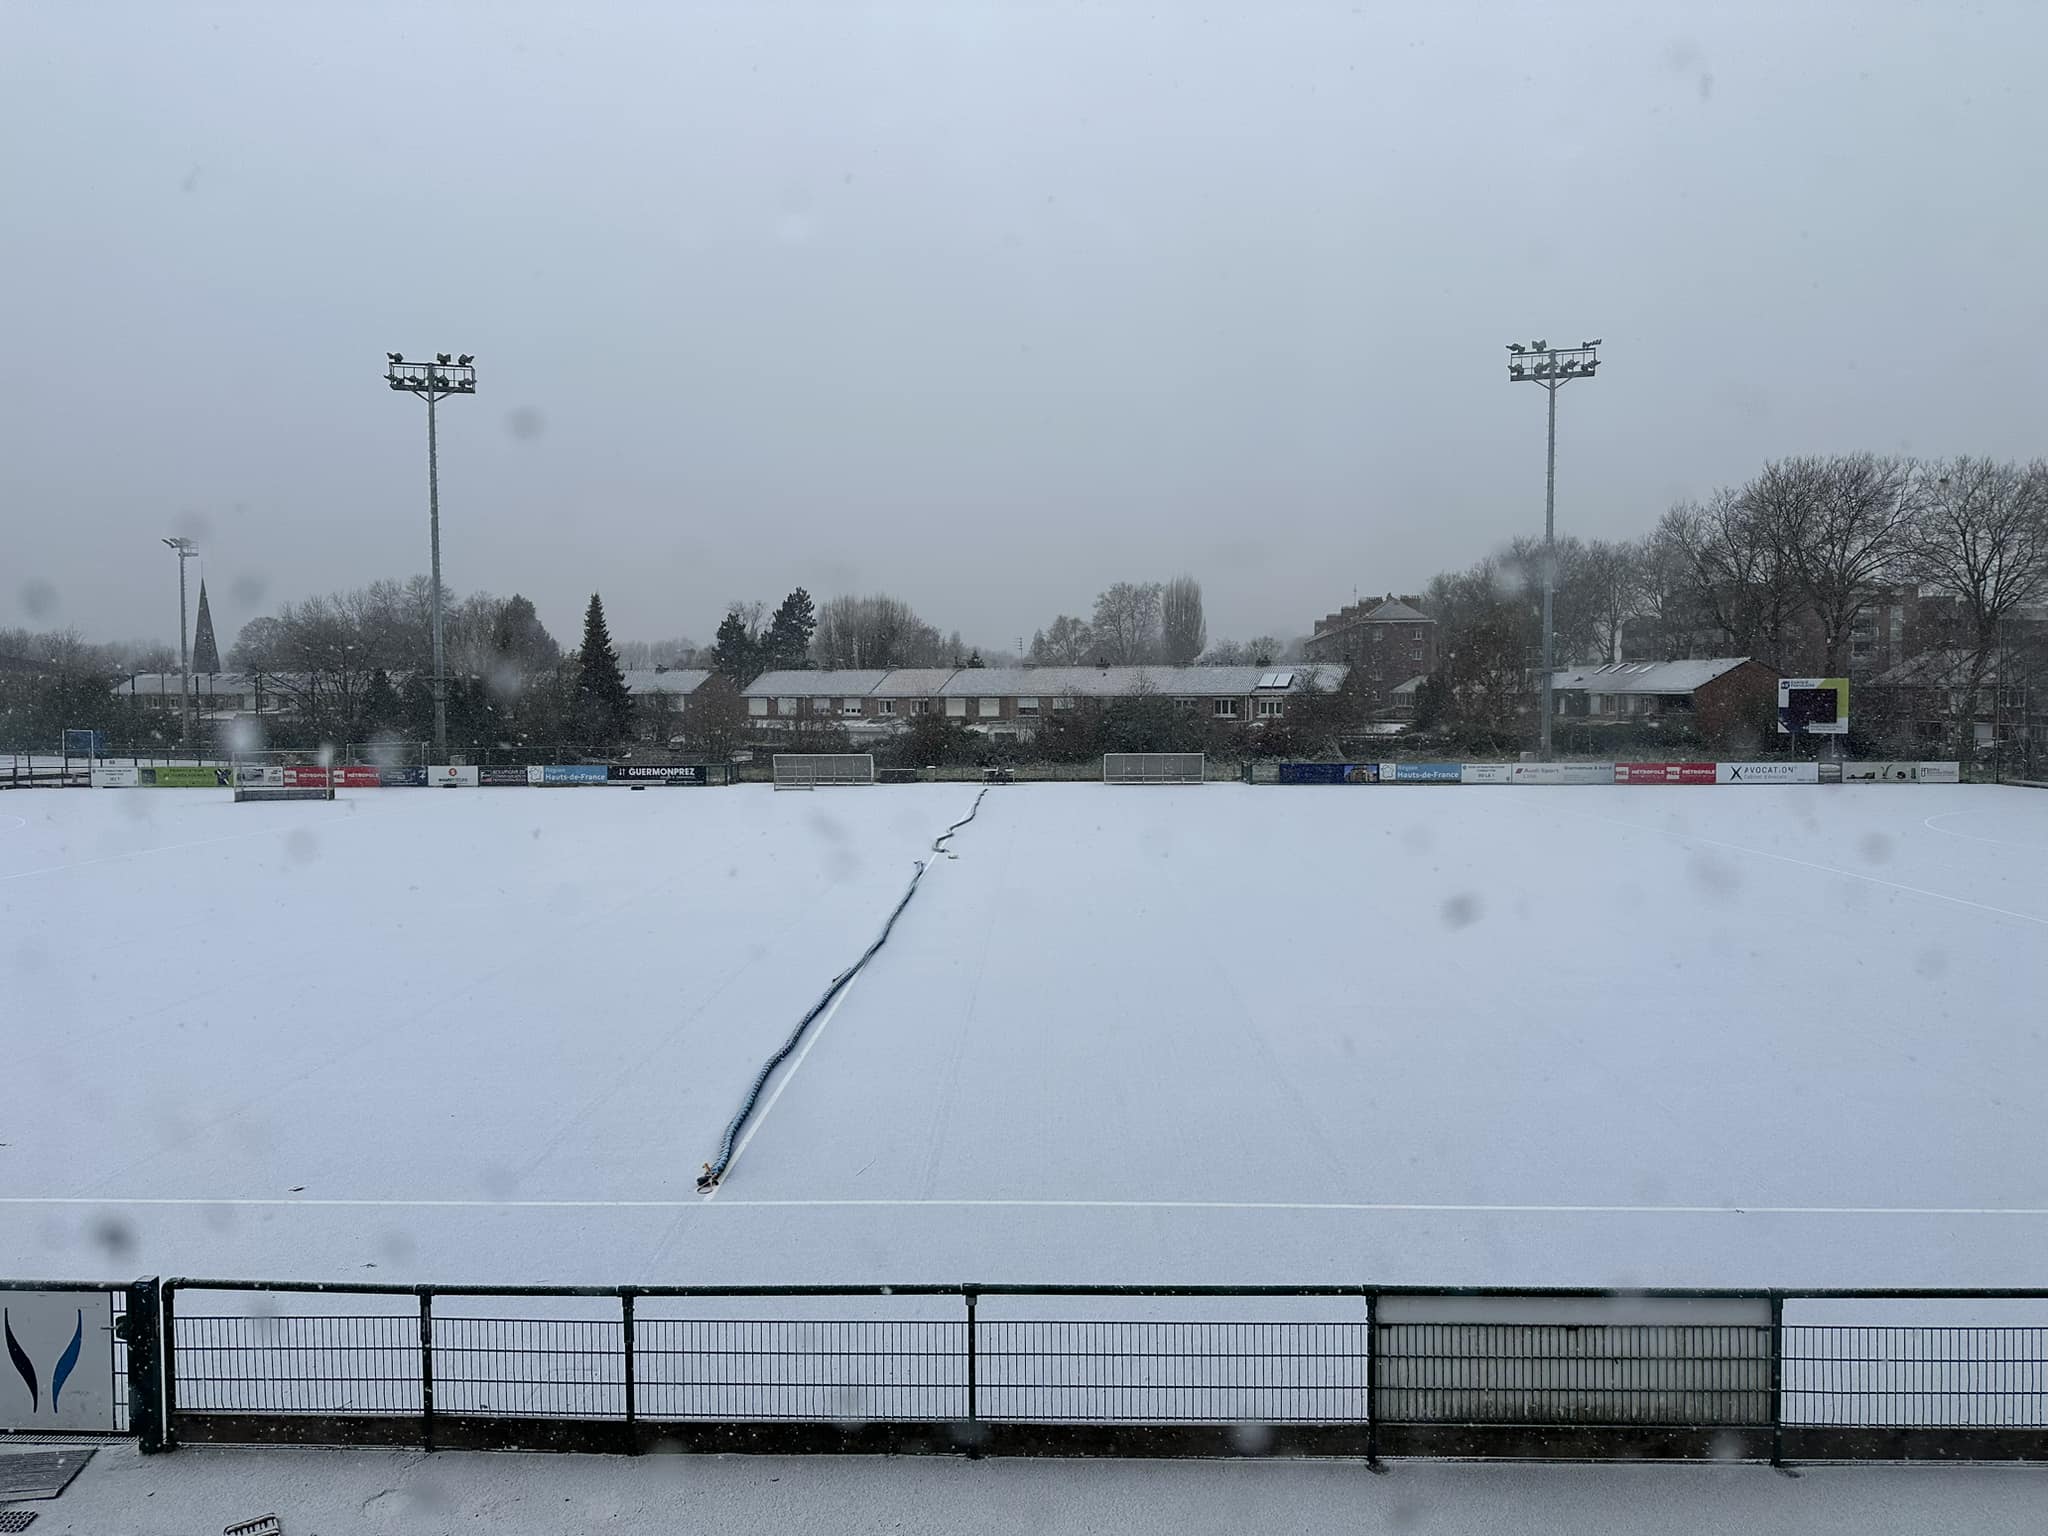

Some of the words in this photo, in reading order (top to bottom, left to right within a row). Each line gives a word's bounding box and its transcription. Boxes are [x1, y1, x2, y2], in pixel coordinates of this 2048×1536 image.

[628, 767, 695, 776] GUERMONPREZ
[1397, 771, 1459, 779] Hauts-de-France
[544, 773, 606, 781] Hauts-de-France
